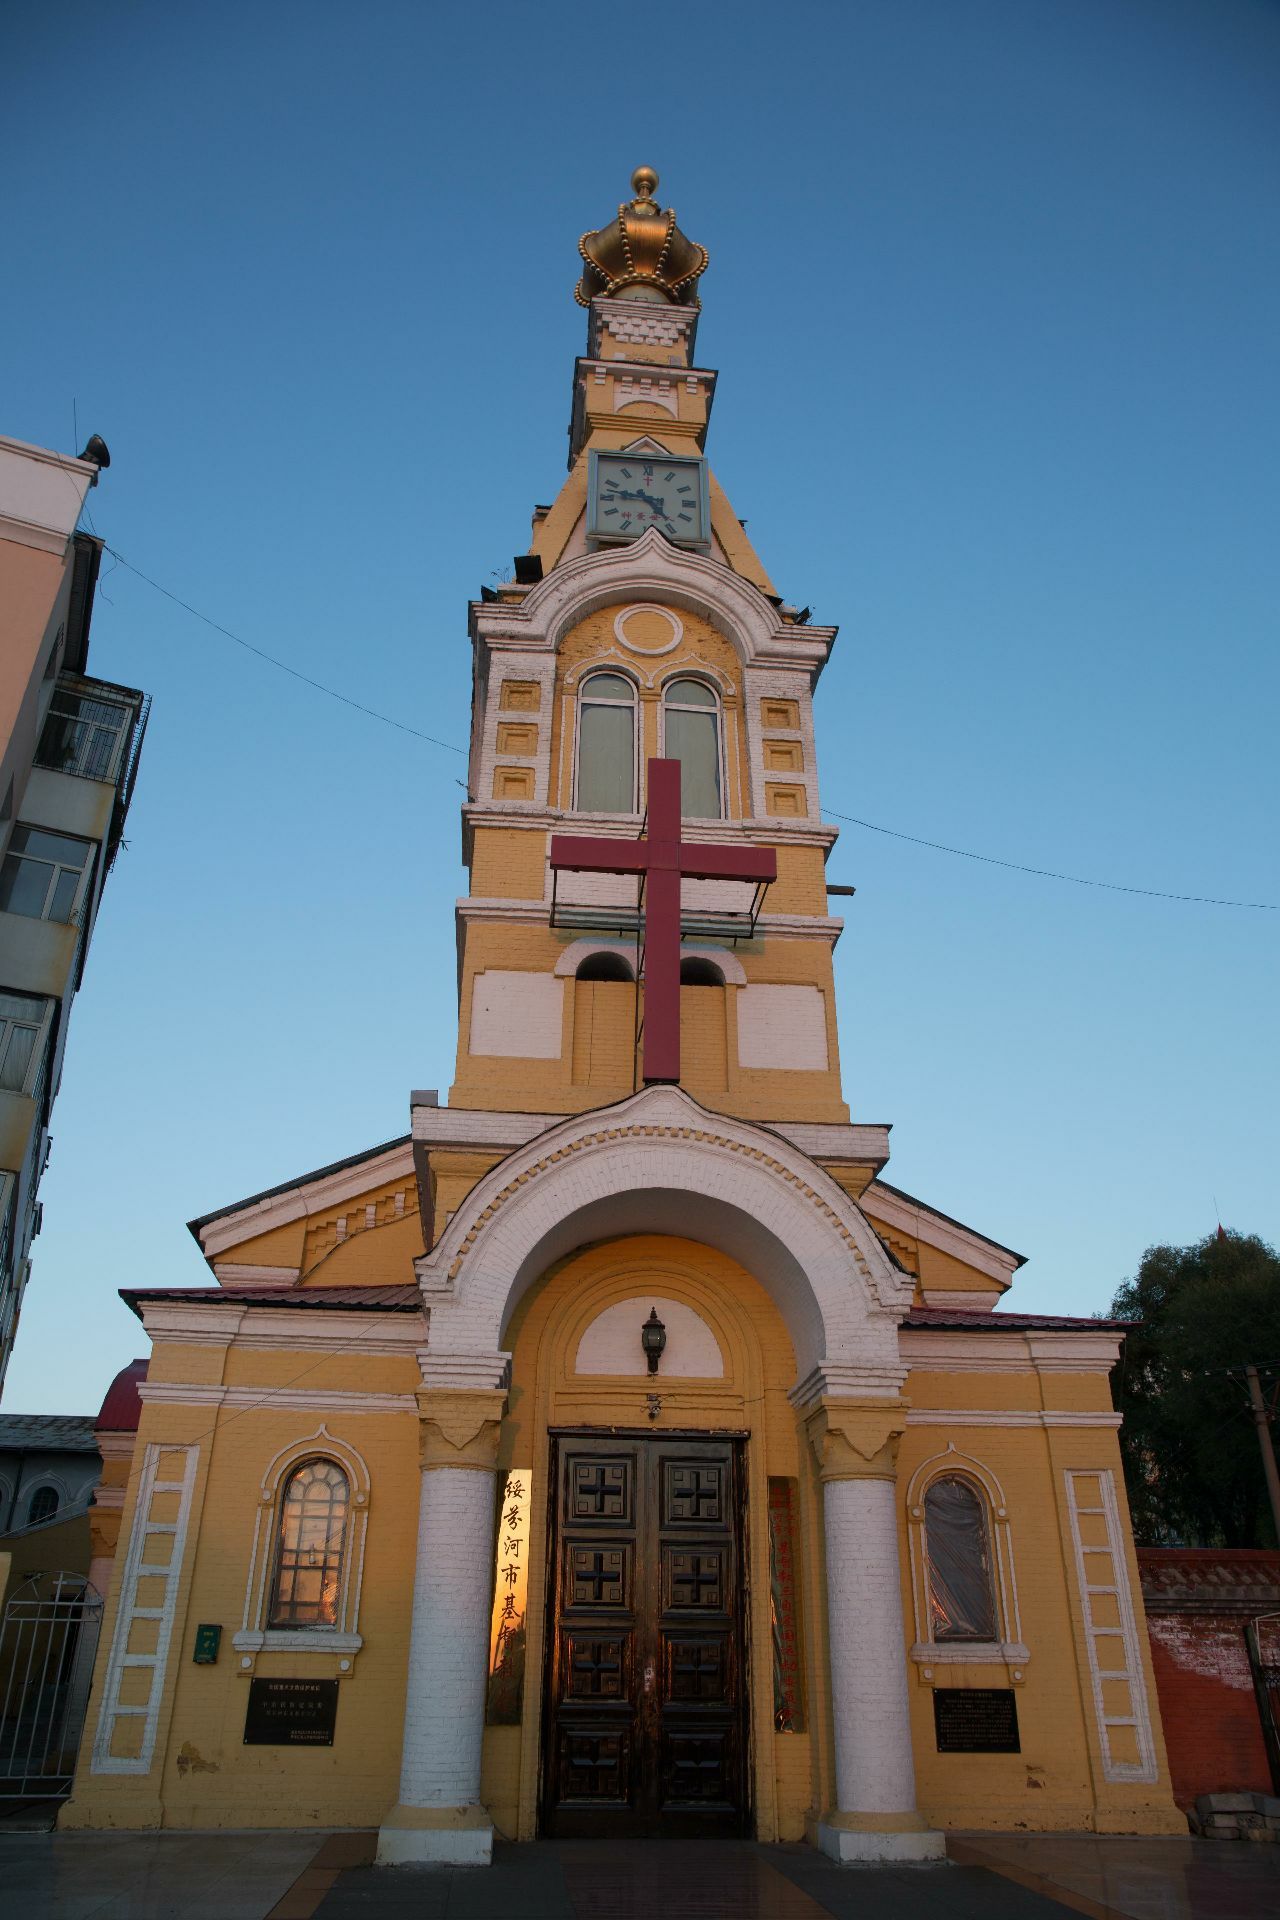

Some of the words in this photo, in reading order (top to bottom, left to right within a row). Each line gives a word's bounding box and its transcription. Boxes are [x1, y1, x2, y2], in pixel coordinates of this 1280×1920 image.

[494, 1479, 526, 1713] 绥芬河市基督教
